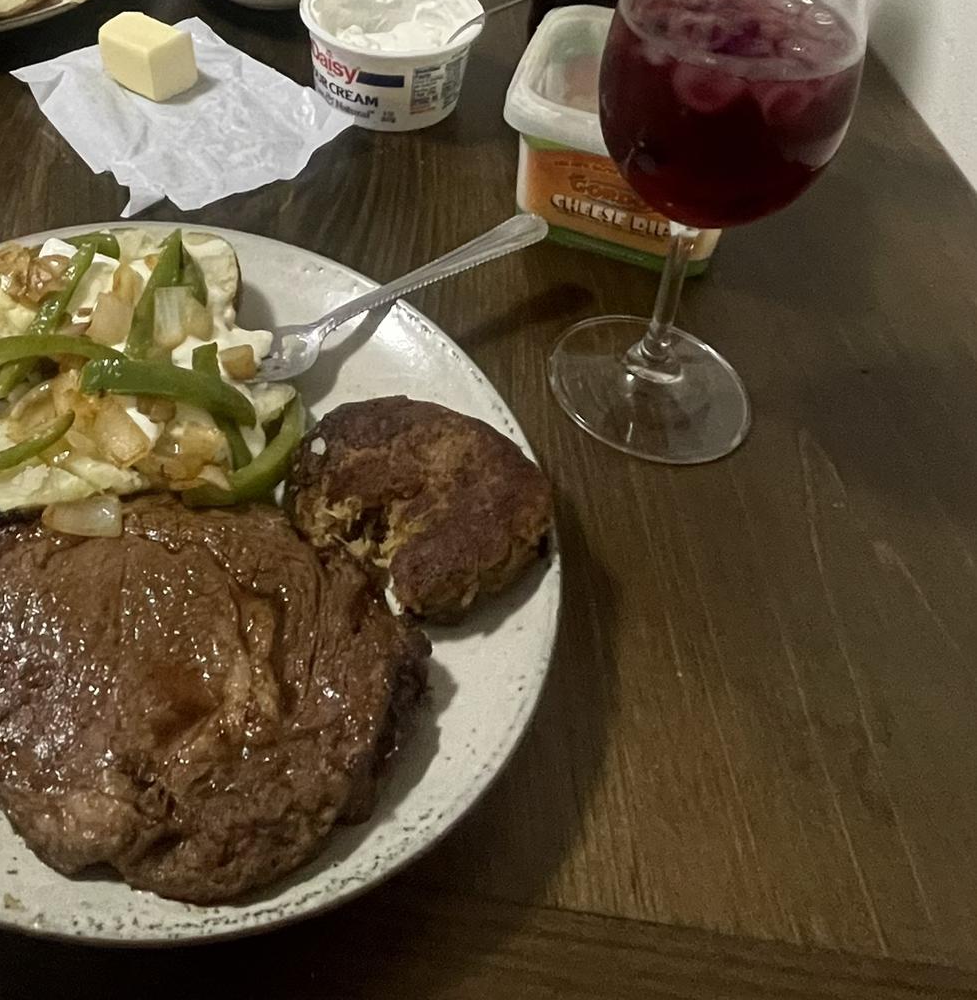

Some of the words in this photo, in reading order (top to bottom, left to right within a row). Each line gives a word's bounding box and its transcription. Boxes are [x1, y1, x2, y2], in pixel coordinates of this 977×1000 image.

[310, 39, 359, 85] Daisy
[329, 81, 379, 108] CREAM
[551, 192, 627, 226] CHEESE
